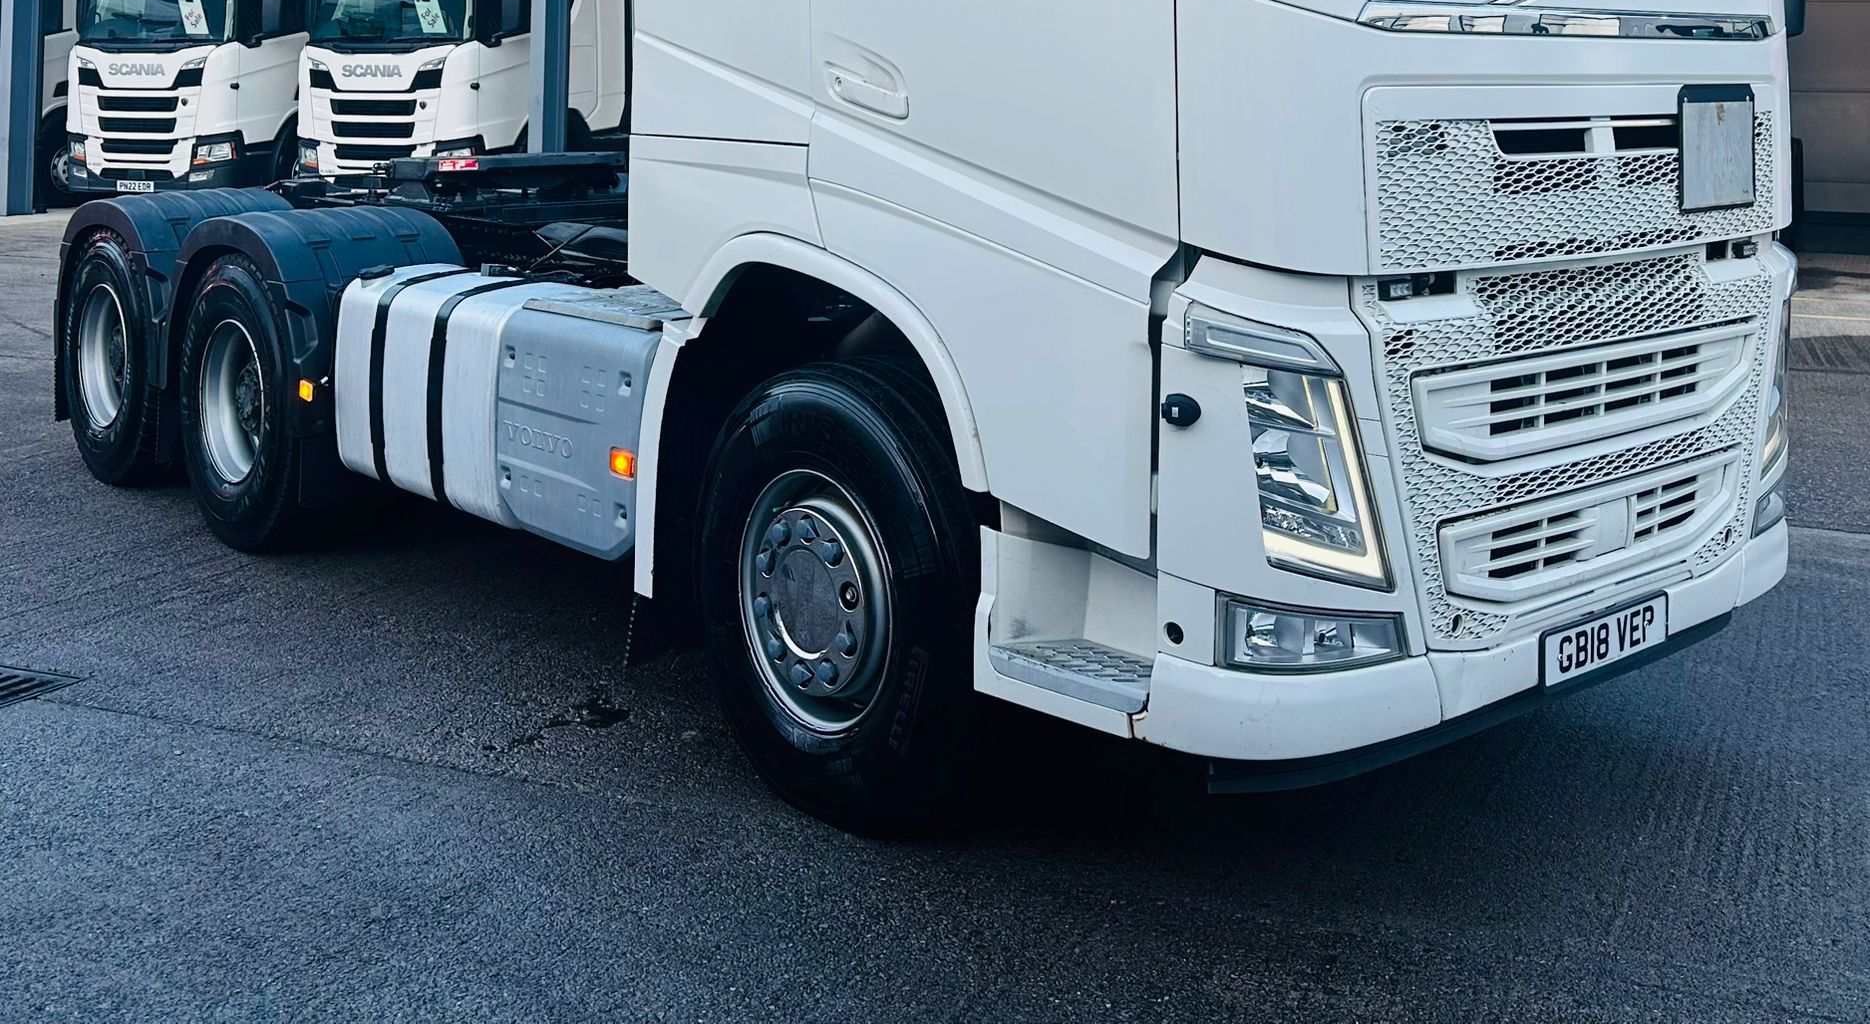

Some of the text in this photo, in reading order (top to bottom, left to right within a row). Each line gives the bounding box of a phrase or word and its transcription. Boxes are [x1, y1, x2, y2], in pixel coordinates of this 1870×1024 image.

[184, 9, 195, 21] For
[190, 13, 203, 29] Sale
[420, 8, 432, 21] For
[427, 13, 440, 29] Sale
[108, 63, 165, 76] SCANIA
[341, 64, 403, 77] SCANIA
[502, 419, 574, 458] VOLVO
[1558, 604, 1655, 674] GB18 VEP
